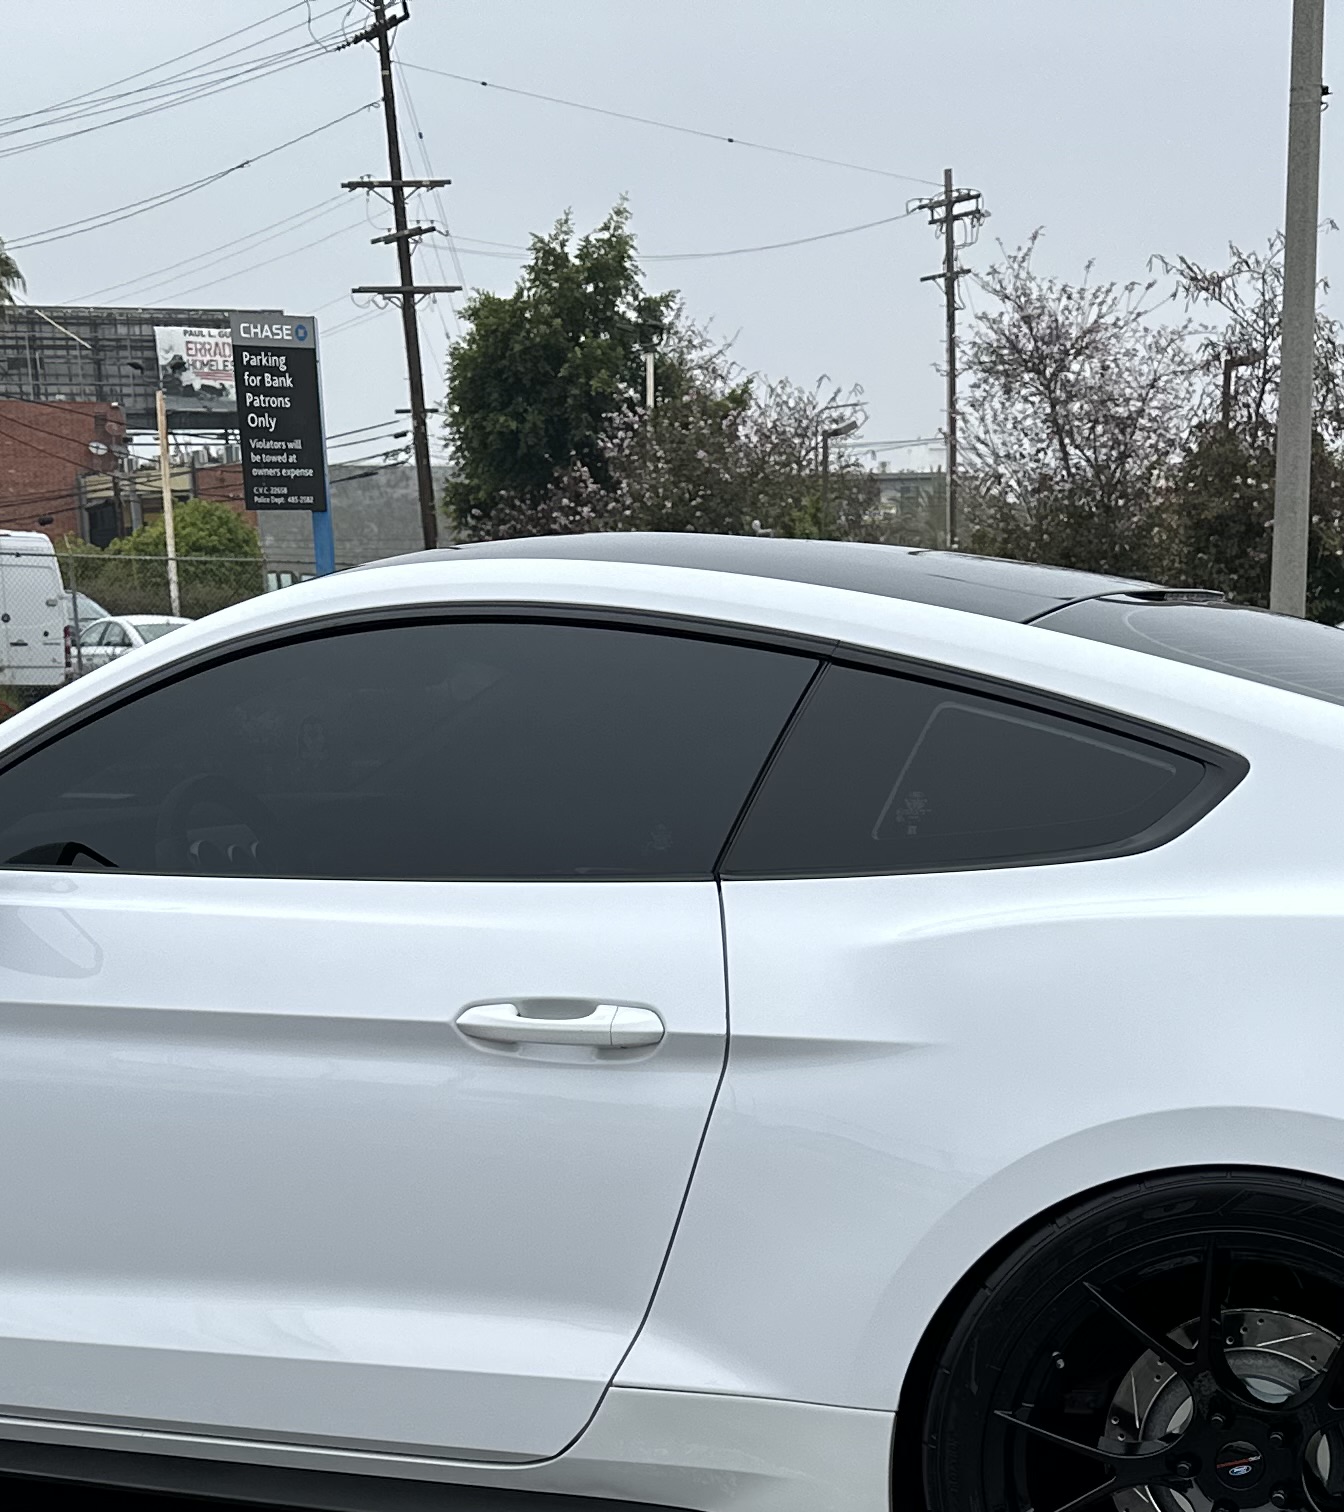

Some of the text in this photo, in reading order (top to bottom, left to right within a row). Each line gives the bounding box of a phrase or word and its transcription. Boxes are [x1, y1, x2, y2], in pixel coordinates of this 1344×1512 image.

[183, 329, 206, 337] PAUL
[239, 323, 293, 340] CHASE
[242, 352, 287, 371] Parking
[244, 372, 294, 388] for Bank
[246, 393, 291, 408] Patrons
[248, 413, 277, 432] Only
[249, 438, 302, 449] Violators will
[250, 452, 297, 463] be towed at
[281, 468, 314, 480] expense
